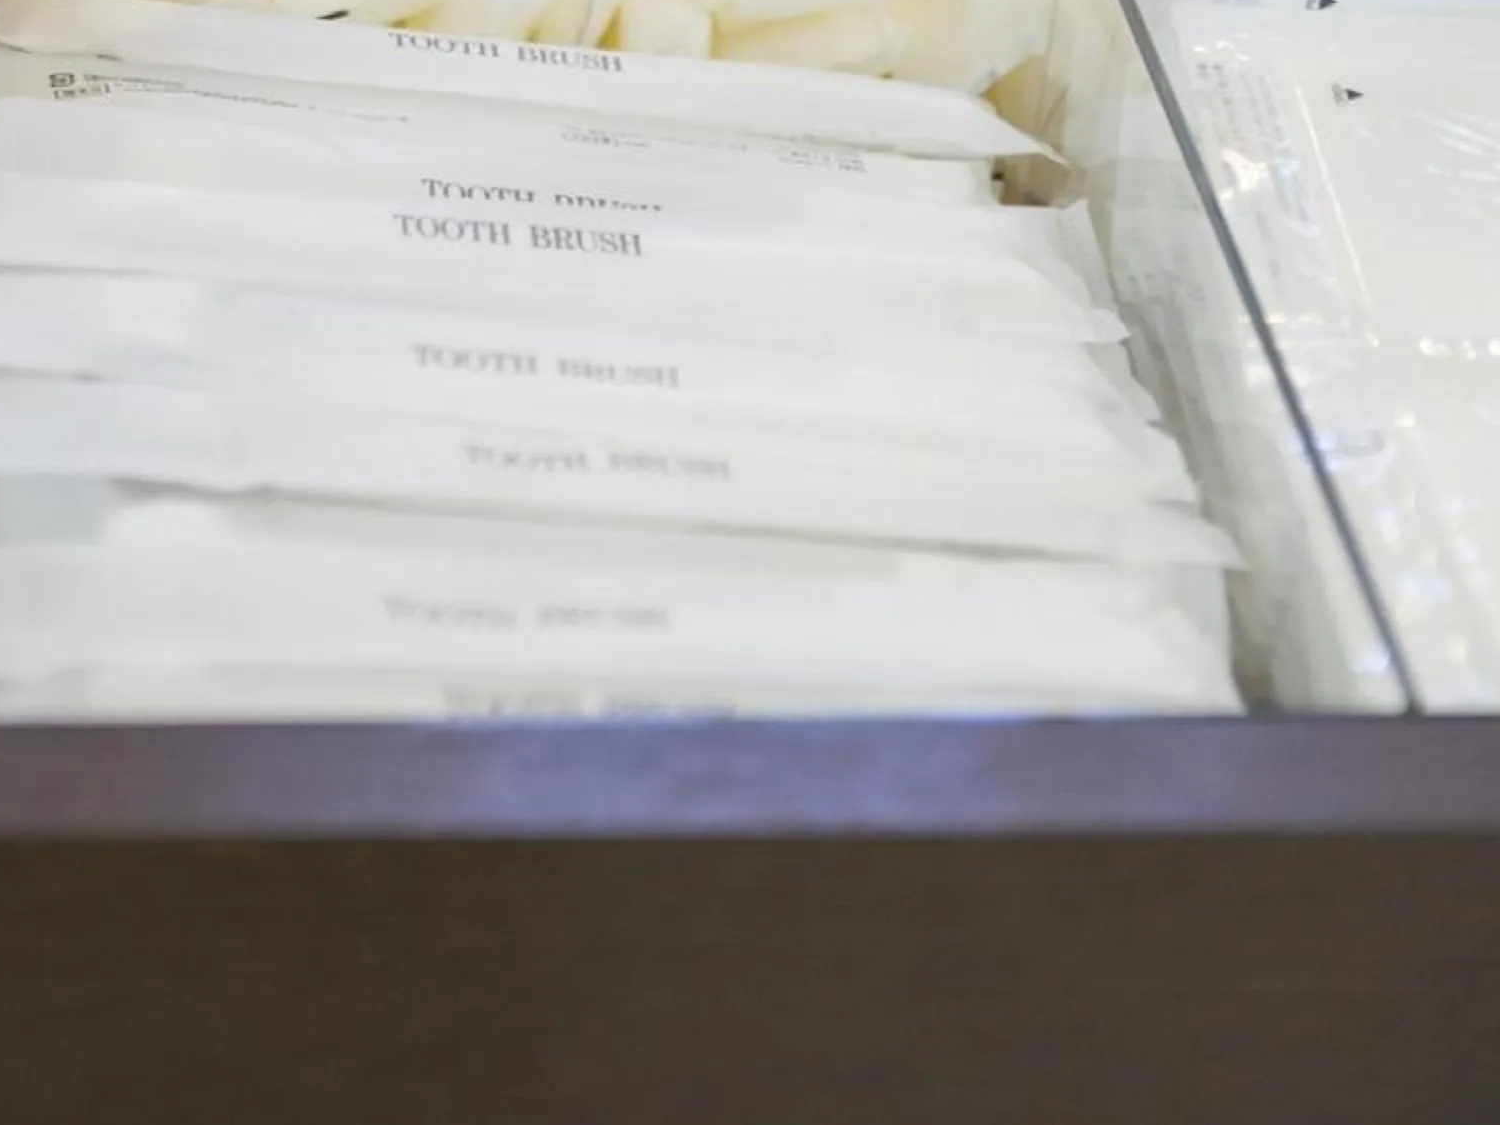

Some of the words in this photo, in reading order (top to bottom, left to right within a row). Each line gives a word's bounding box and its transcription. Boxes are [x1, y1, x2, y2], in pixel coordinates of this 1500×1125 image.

[388, 31, 501, 59] TOOTH
[516, 45, 623, 73] BRUSH
[392, 213, 512, 247] TOOTH
[527, 223, 644, 257] BRUSH
